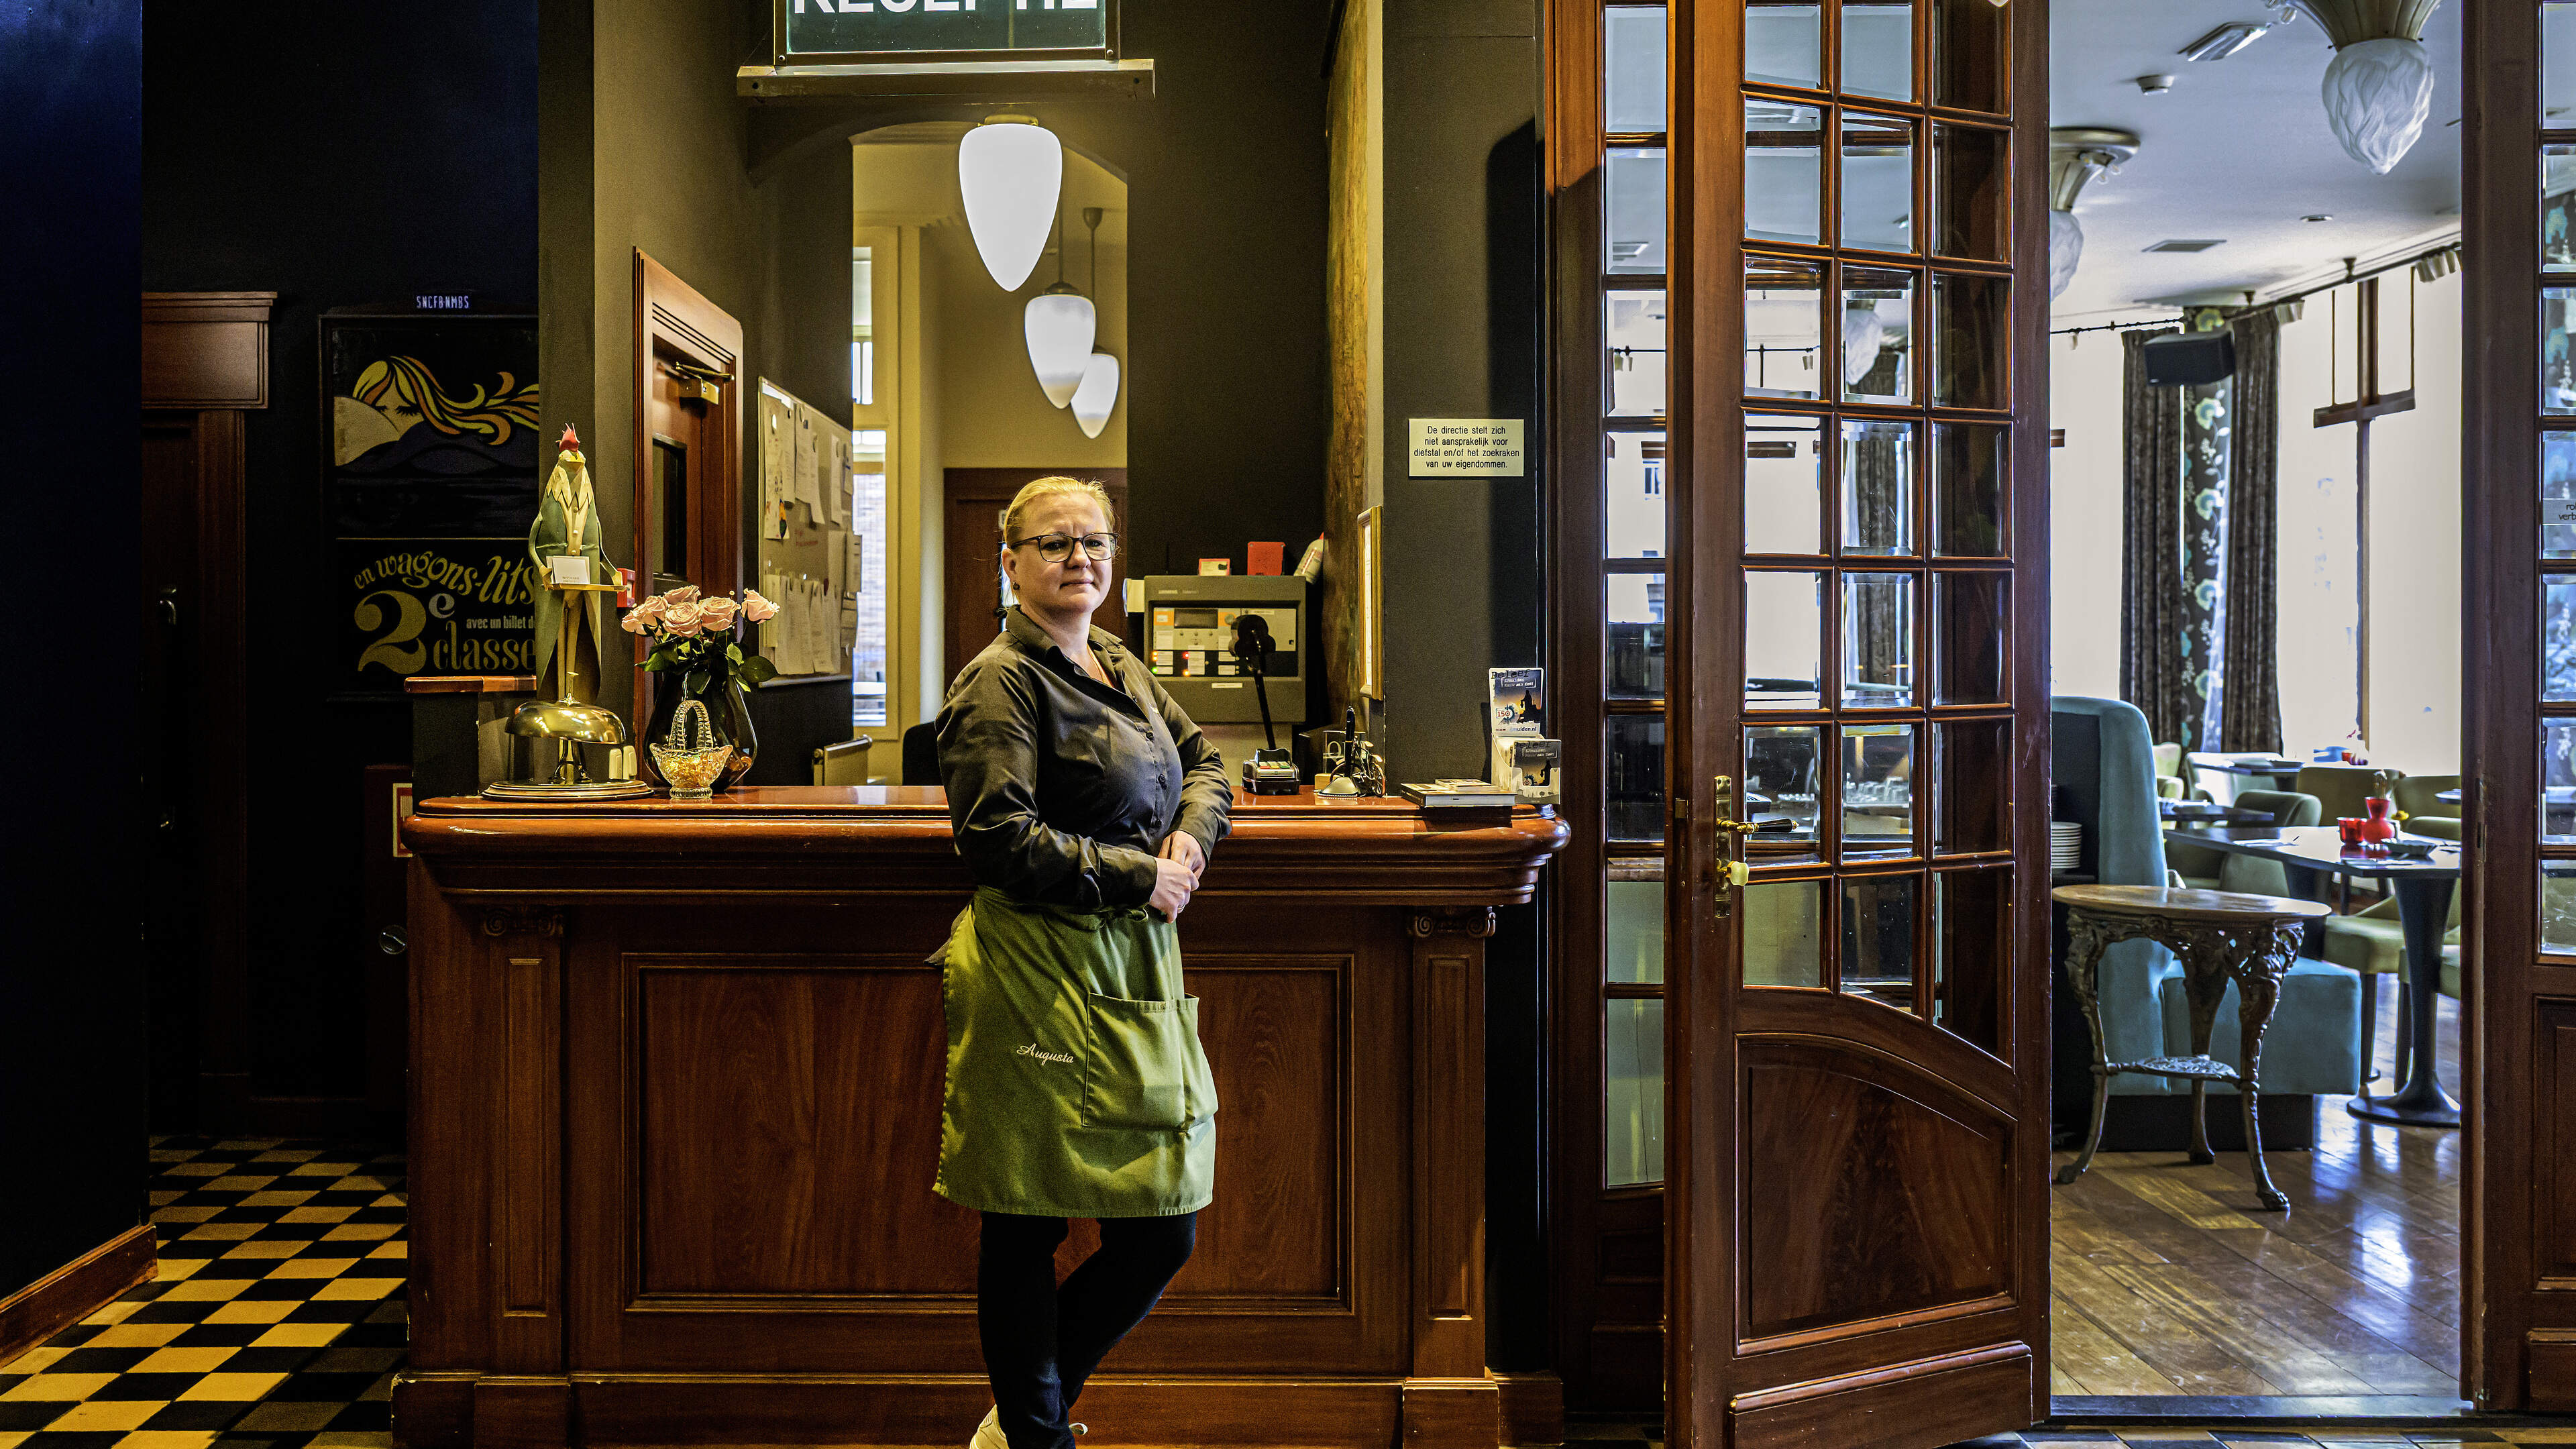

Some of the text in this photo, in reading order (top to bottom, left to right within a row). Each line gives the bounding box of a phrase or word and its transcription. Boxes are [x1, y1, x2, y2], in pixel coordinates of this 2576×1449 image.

[1428, 426, 1506, 434] De directie stelt zich
[1424, 437, 1438, 445] niet
[1442, 437, 1489, 447] aansprakelijk
[1413, 448, 1519, 457] diefstal en/of het zoekraken
[1456, 460, 1507, 470] eigendommen.
[354, 568, 376, 589] en
[466, 618, 488, 629] avec
[490, 618, 502, 629] un
[503, 615, 527, 629] billet
[433, 620, 536, 670] classe
[1491, 669, 1530, 680] Beleef
[1016, 1042, 1074, 1065] Augusta
